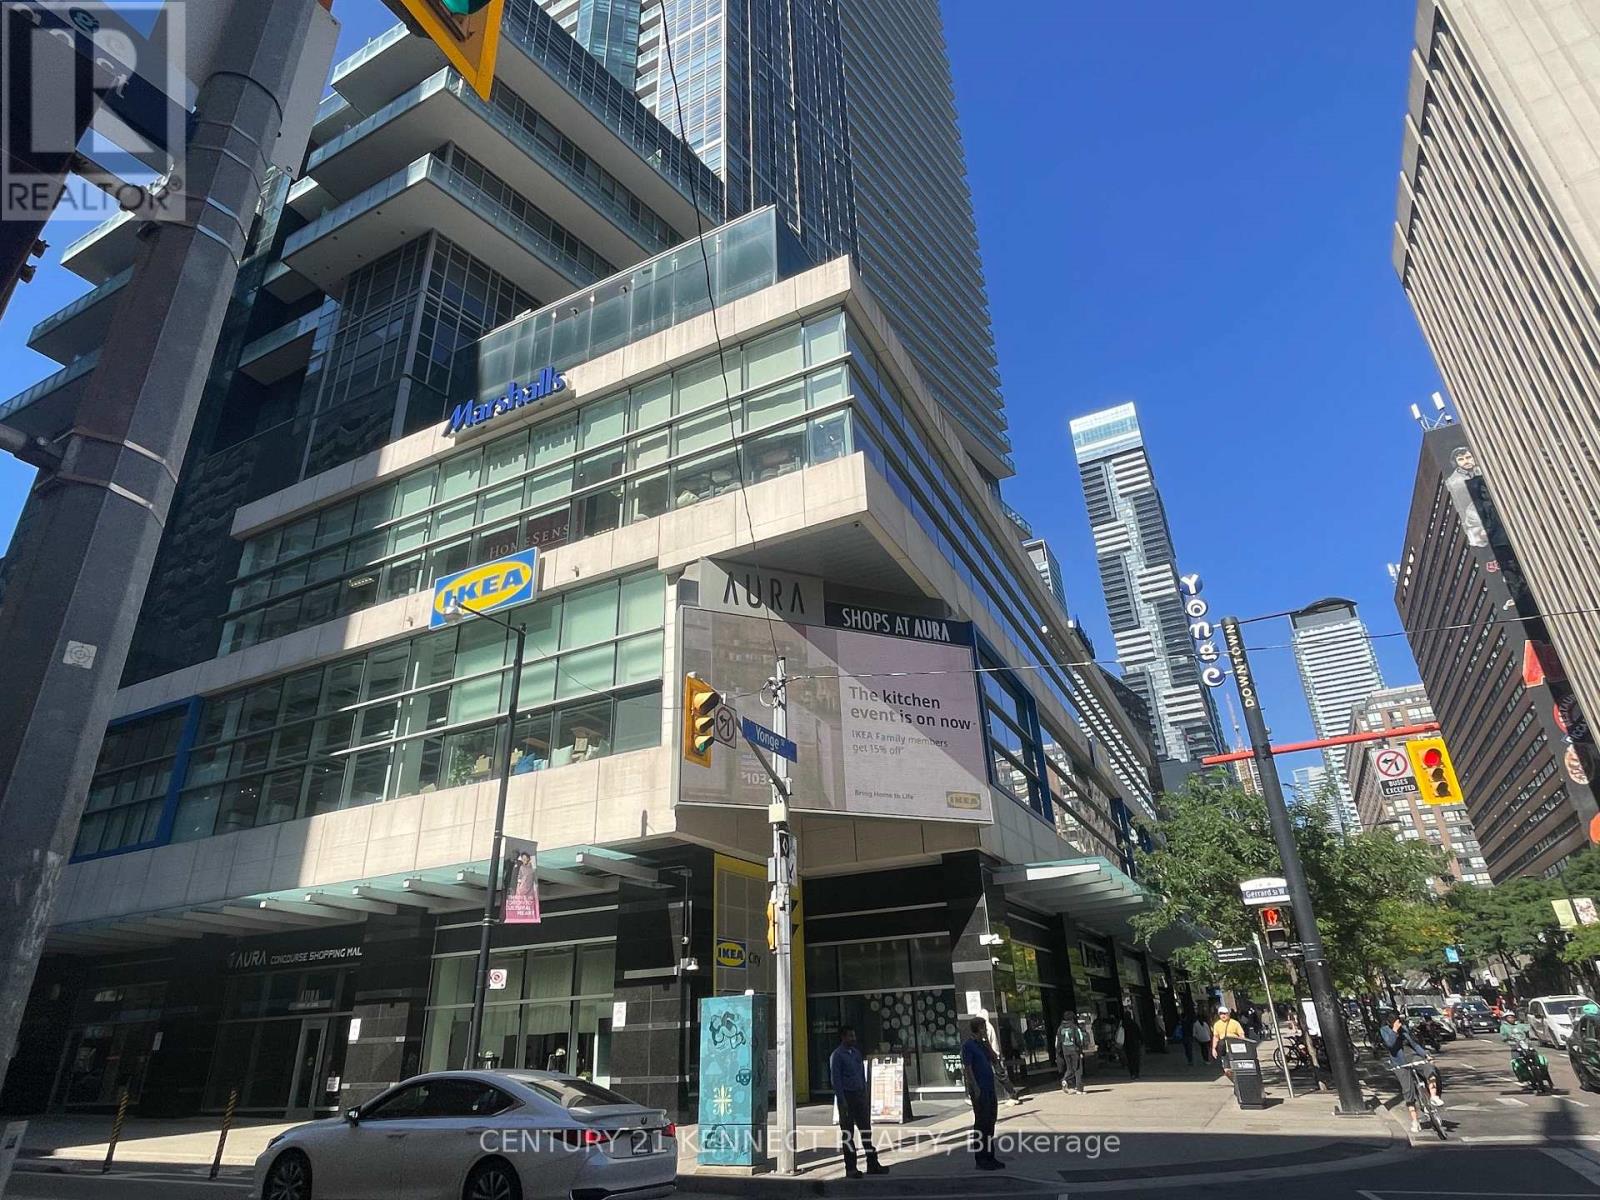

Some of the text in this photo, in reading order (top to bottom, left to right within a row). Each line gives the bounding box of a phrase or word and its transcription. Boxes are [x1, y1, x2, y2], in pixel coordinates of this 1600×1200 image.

[442, 367, 567, 437] Marshalls
[443, 568, 523, 608] IKEA
[723, 571, 805, 614] AURA
[842, 607, 950, 642] SHOPS AT AURA
[1225, 624, 1255, 708] DOWNTOWN
[849, 686, 941, 709] The kitchen
[851, 707, 895, 723] event
[900, 710, 912, 724] is
[916, 714, 937, 727] on
[755, 725, 780, 750] Yonge
[852, 730, 949, 748] IKEA Family members
[852, 745, 868, 754] get
[870, 744, 887, 754] 15%
[1385, 785, 1415, 794] EXCEPTED
[1388, 778, 1408, 787] BUSES
[1245, 889, 1272, 898] Gerrard
[235, 950, 266, 968] AURA
[270, 952, 308, 965] CONCOURSE
[309, 948, 346, 960] SHOPPING
[718, 948, 762, 967] IKEA City
